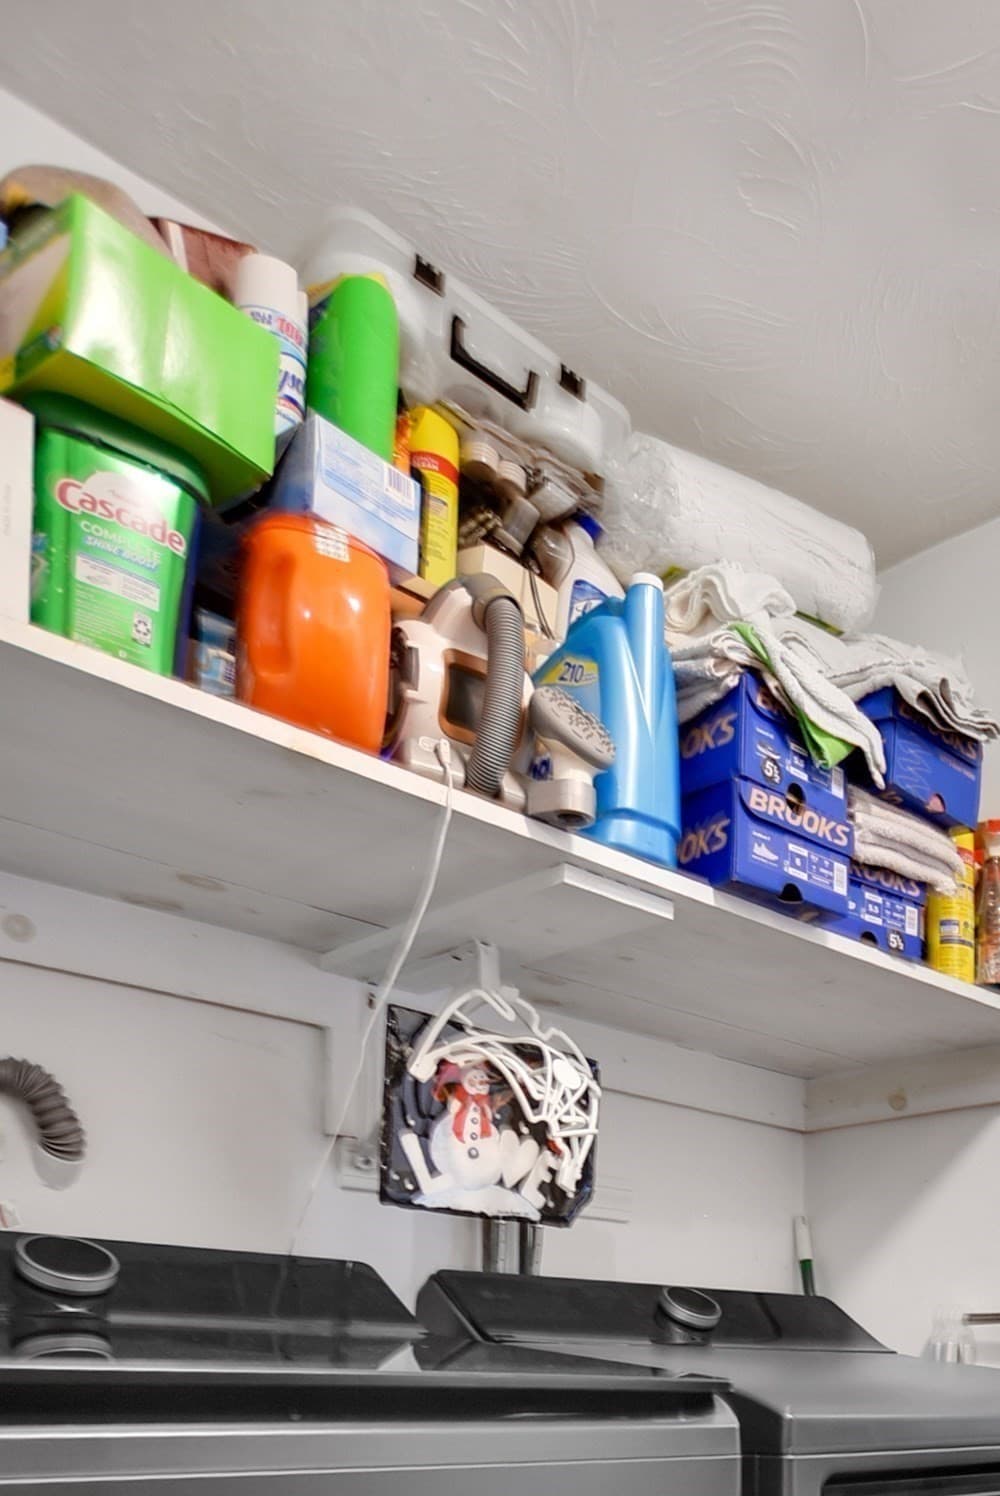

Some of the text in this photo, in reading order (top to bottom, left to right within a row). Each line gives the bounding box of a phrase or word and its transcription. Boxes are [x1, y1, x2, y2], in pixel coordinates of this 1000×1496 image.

[56, 478, 186, 556] Cascade
[558, 661, 585, 683] 210
[680, 712, 738, 760] OKS
[678, 818, 731, 864] OKS
[750, 787, 850, 847] BROOKS
